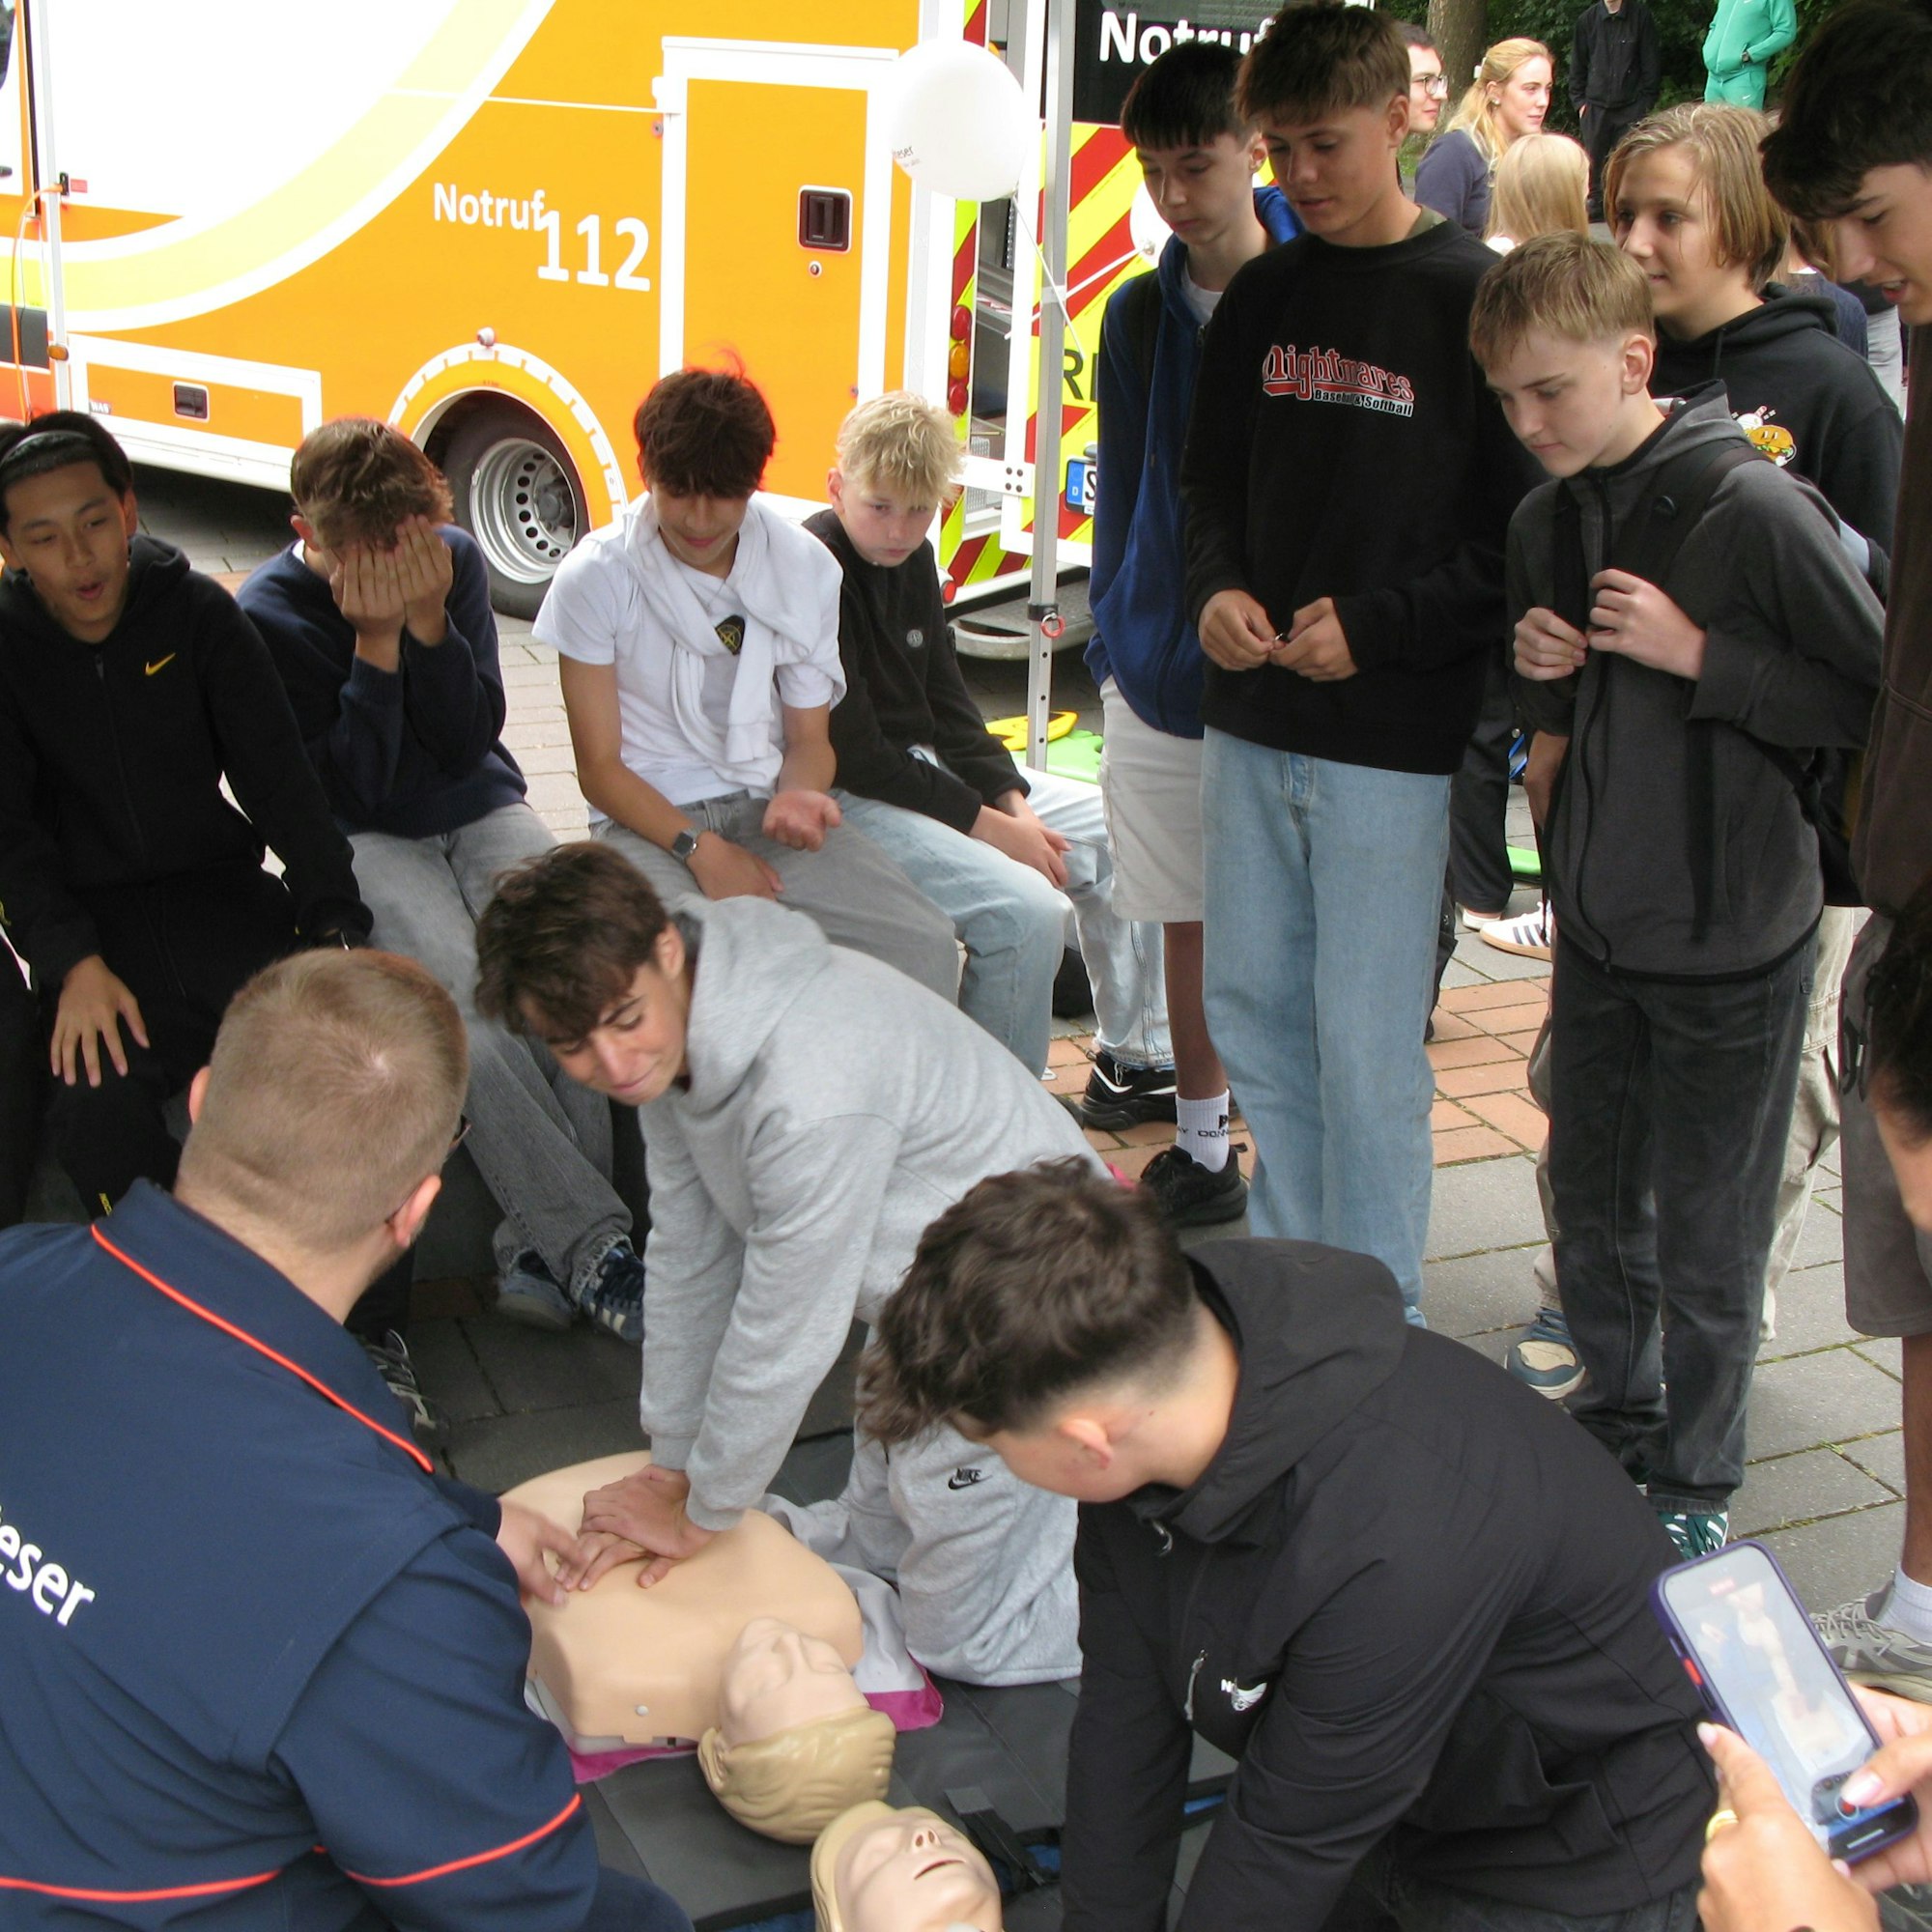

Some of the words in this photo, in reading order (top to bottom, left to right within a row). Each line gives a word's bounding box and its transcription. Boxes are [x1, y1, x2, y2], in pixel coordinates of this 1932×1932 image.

[434, 183, 546, 231] Notruf
[537, 210, 651, 292] 112
[1263, 345, 1414, 403] Nightmares
[1364, 396, 1414, 416] Softball
[0, 1505, 96, 1627] eser
